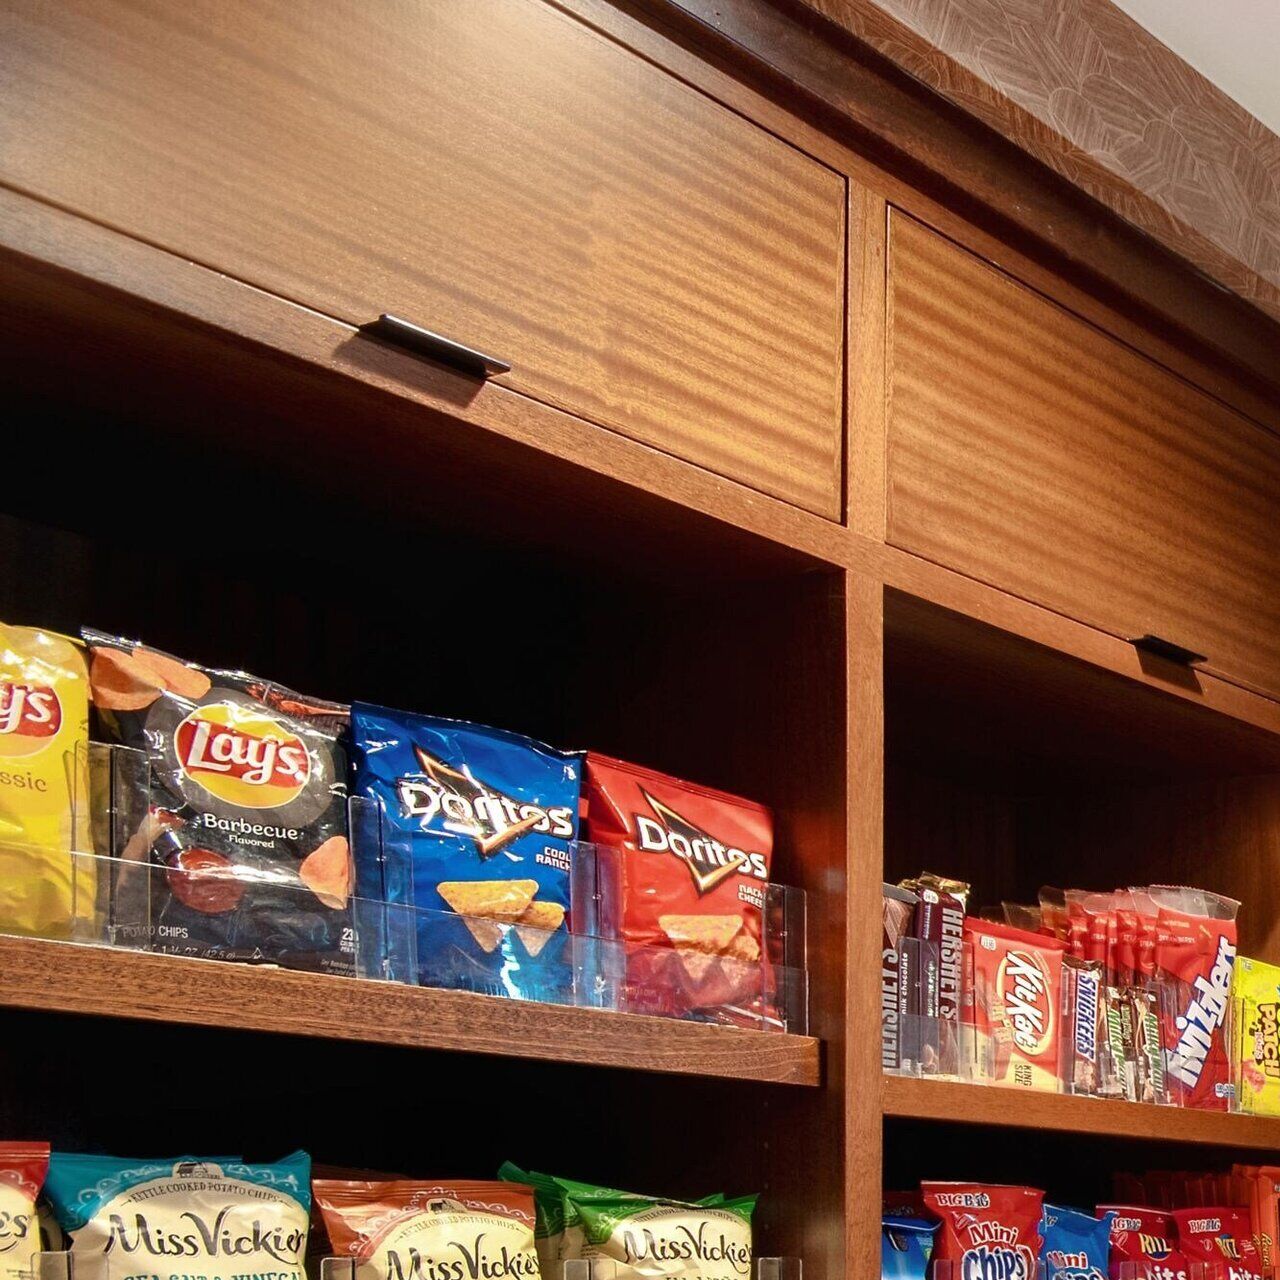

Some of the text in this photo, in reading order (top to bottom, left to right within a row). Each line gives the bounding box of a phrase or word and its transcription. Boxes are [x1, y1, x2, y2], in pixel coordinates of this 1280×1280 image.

[187, 719, 307, 785] Lay's
[203, 813, 299, 841] Barbecue
[228, 834, 275, 850] Flavored
[636, 814, 769, 880] Doritos
[158, 924, 189, 940] CHIPS
[1076, 973, 1096, 1061] SNICKERS
[1014, 1064, 1023, 1084] SIZE
[1023, 1065, 1032, 1087] KING
[131, 1182, 246, 1203] KETTLE COOKED POTATO
[970, 1221, 1019, 1245] Mini
